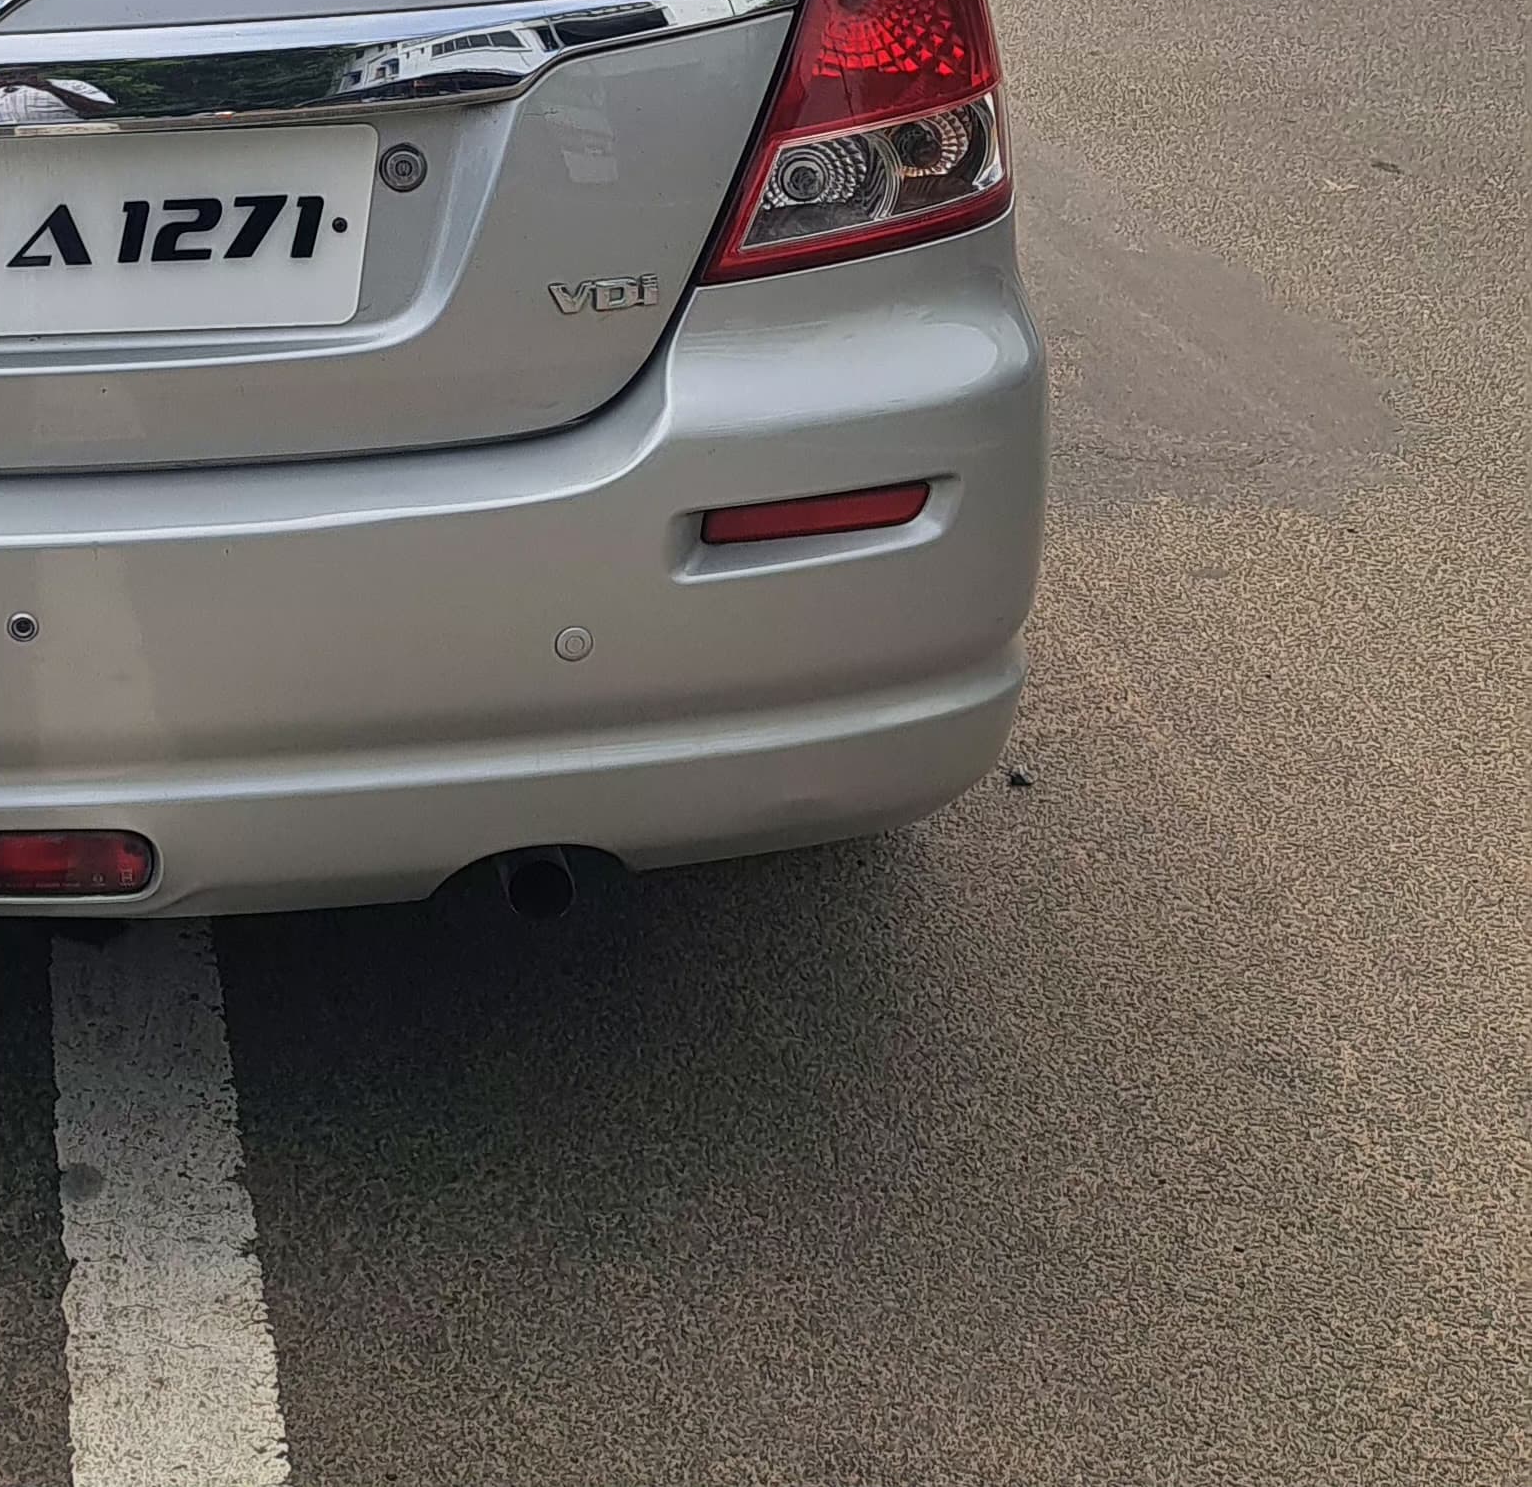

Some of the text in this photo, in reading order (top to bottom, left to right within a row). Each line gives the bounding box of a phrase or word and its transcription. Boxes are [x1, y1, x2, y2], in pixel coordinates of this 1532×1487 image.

[6, 204, 91, 268] A
[118, 194, 325, 264] 1271
[548, 273, 659, 315] VDi
